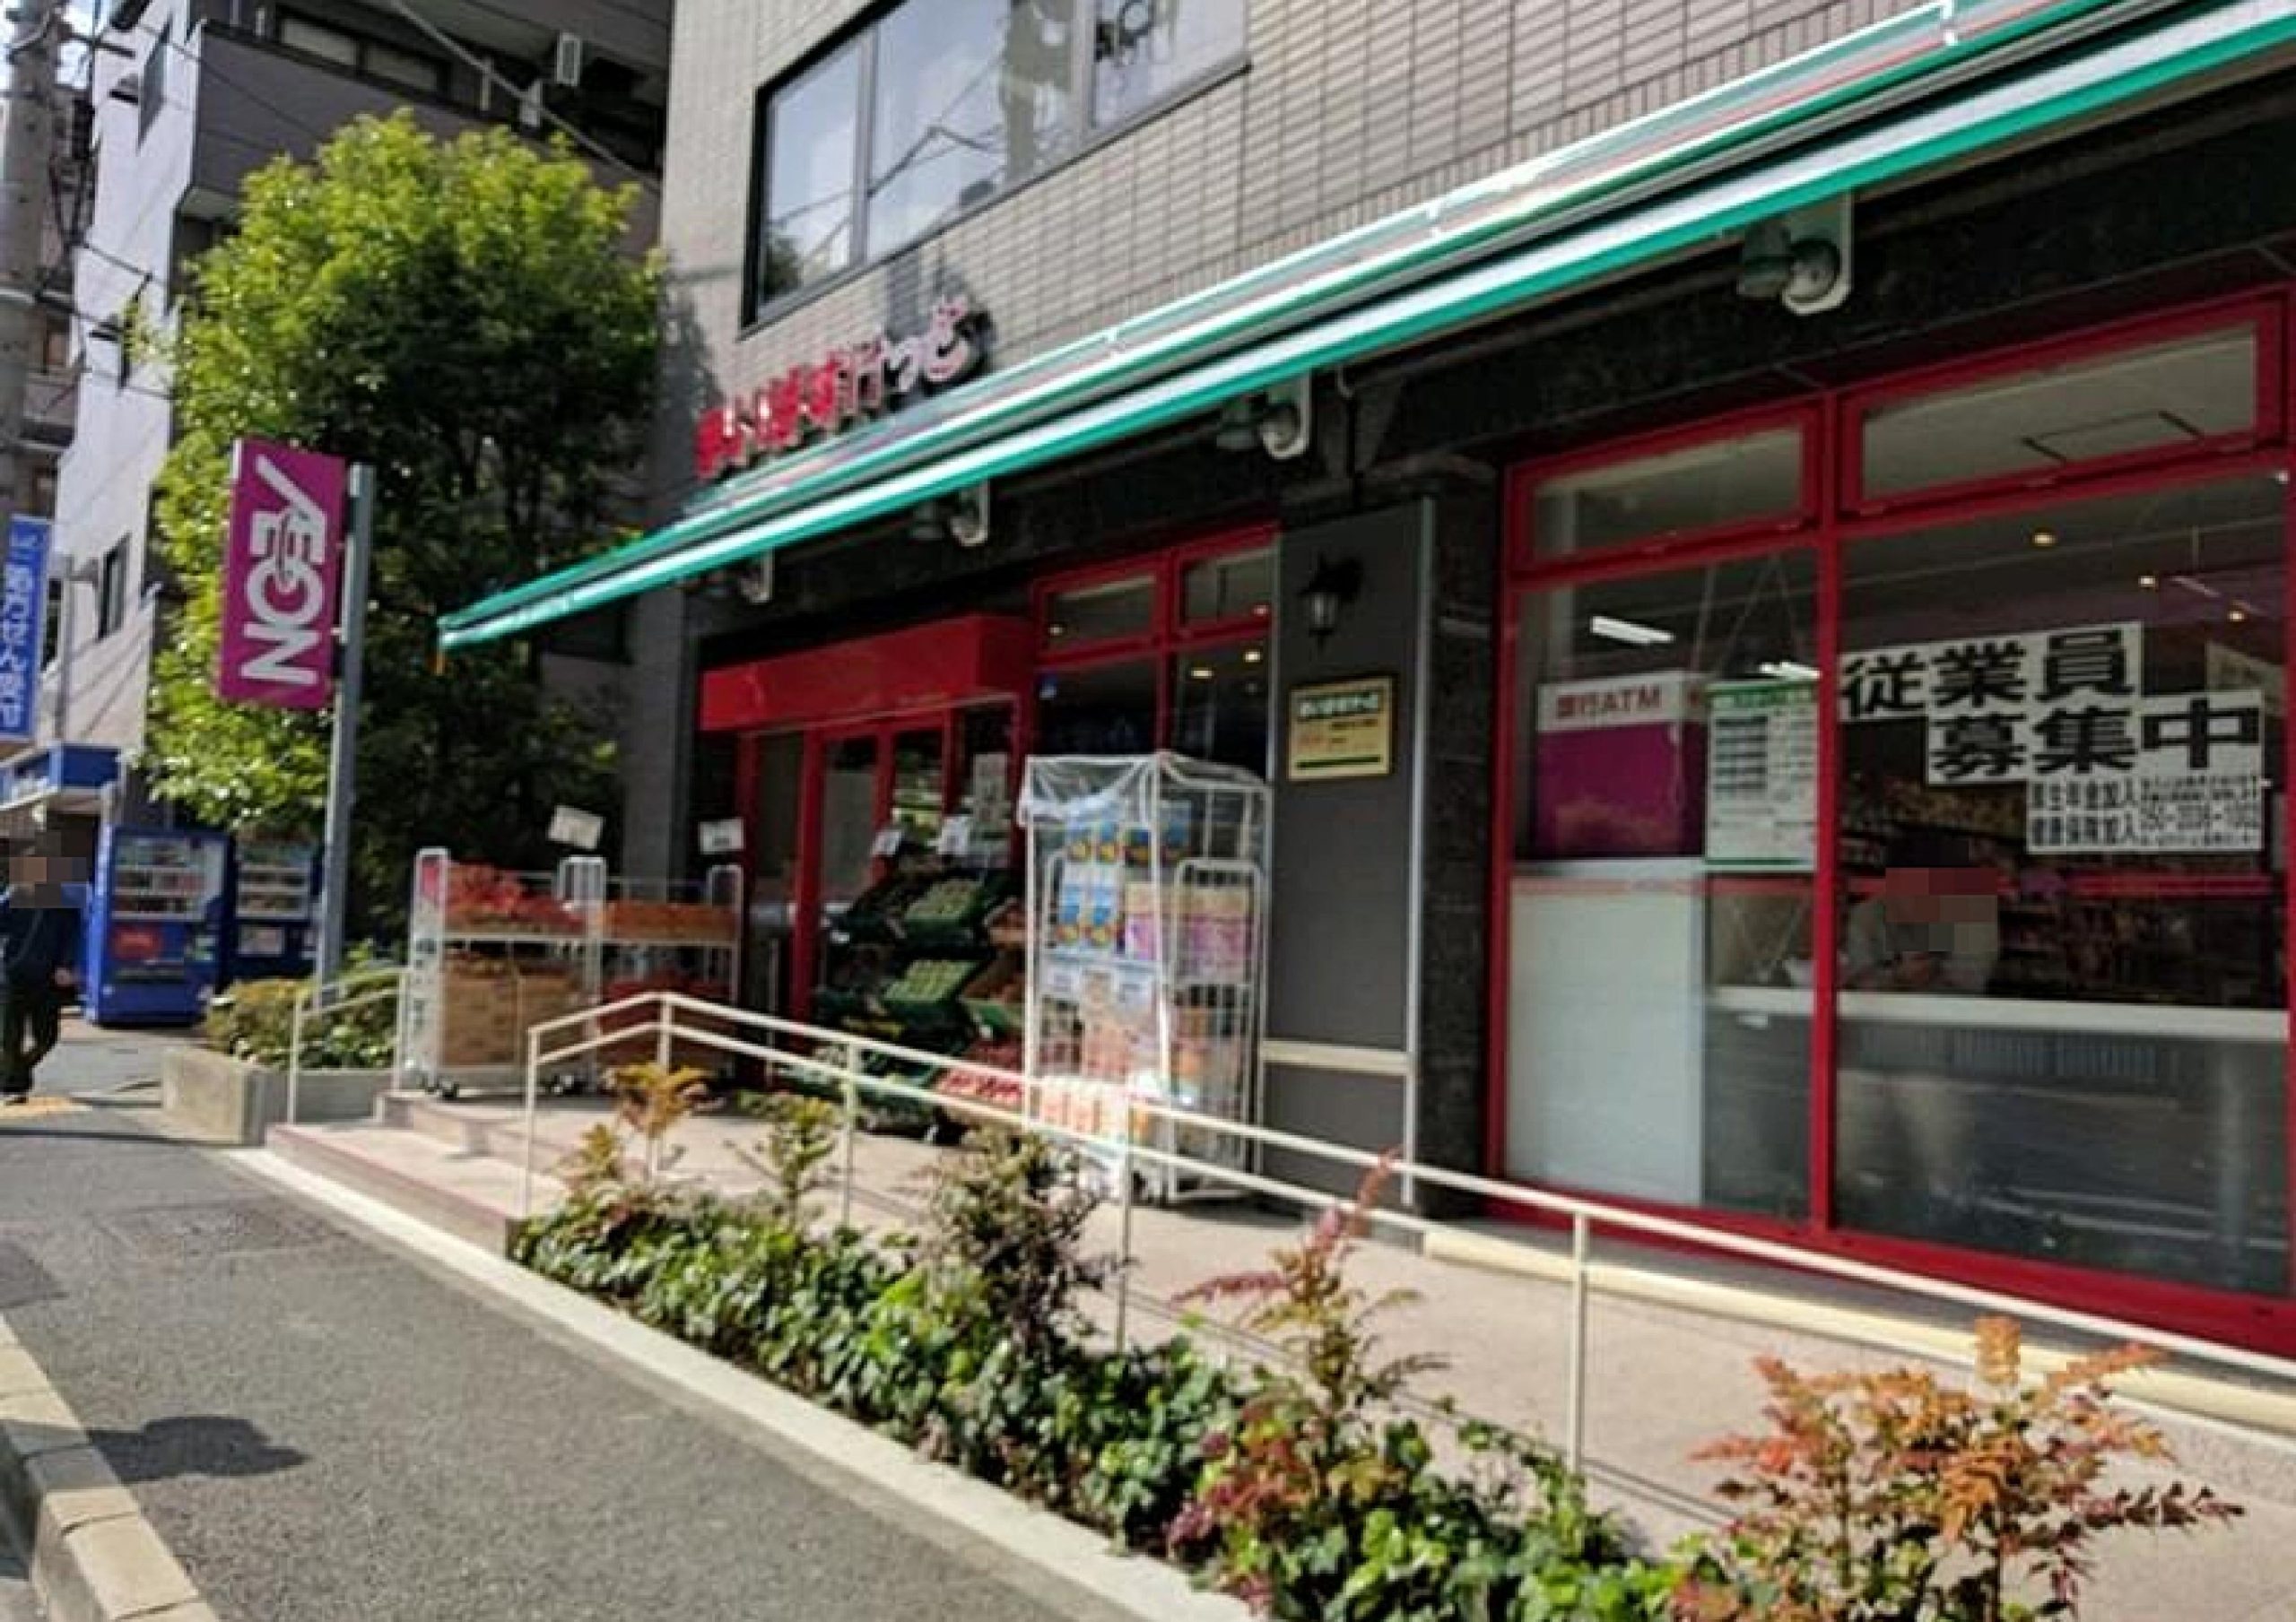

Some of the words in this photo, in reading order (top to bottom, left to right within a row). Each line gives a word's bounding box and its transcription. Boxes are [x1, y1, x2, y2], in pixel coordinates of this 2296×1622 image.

[1841, 629, 2135, 717] 従業員
[1928, 698, 2261, 777] 募集中
